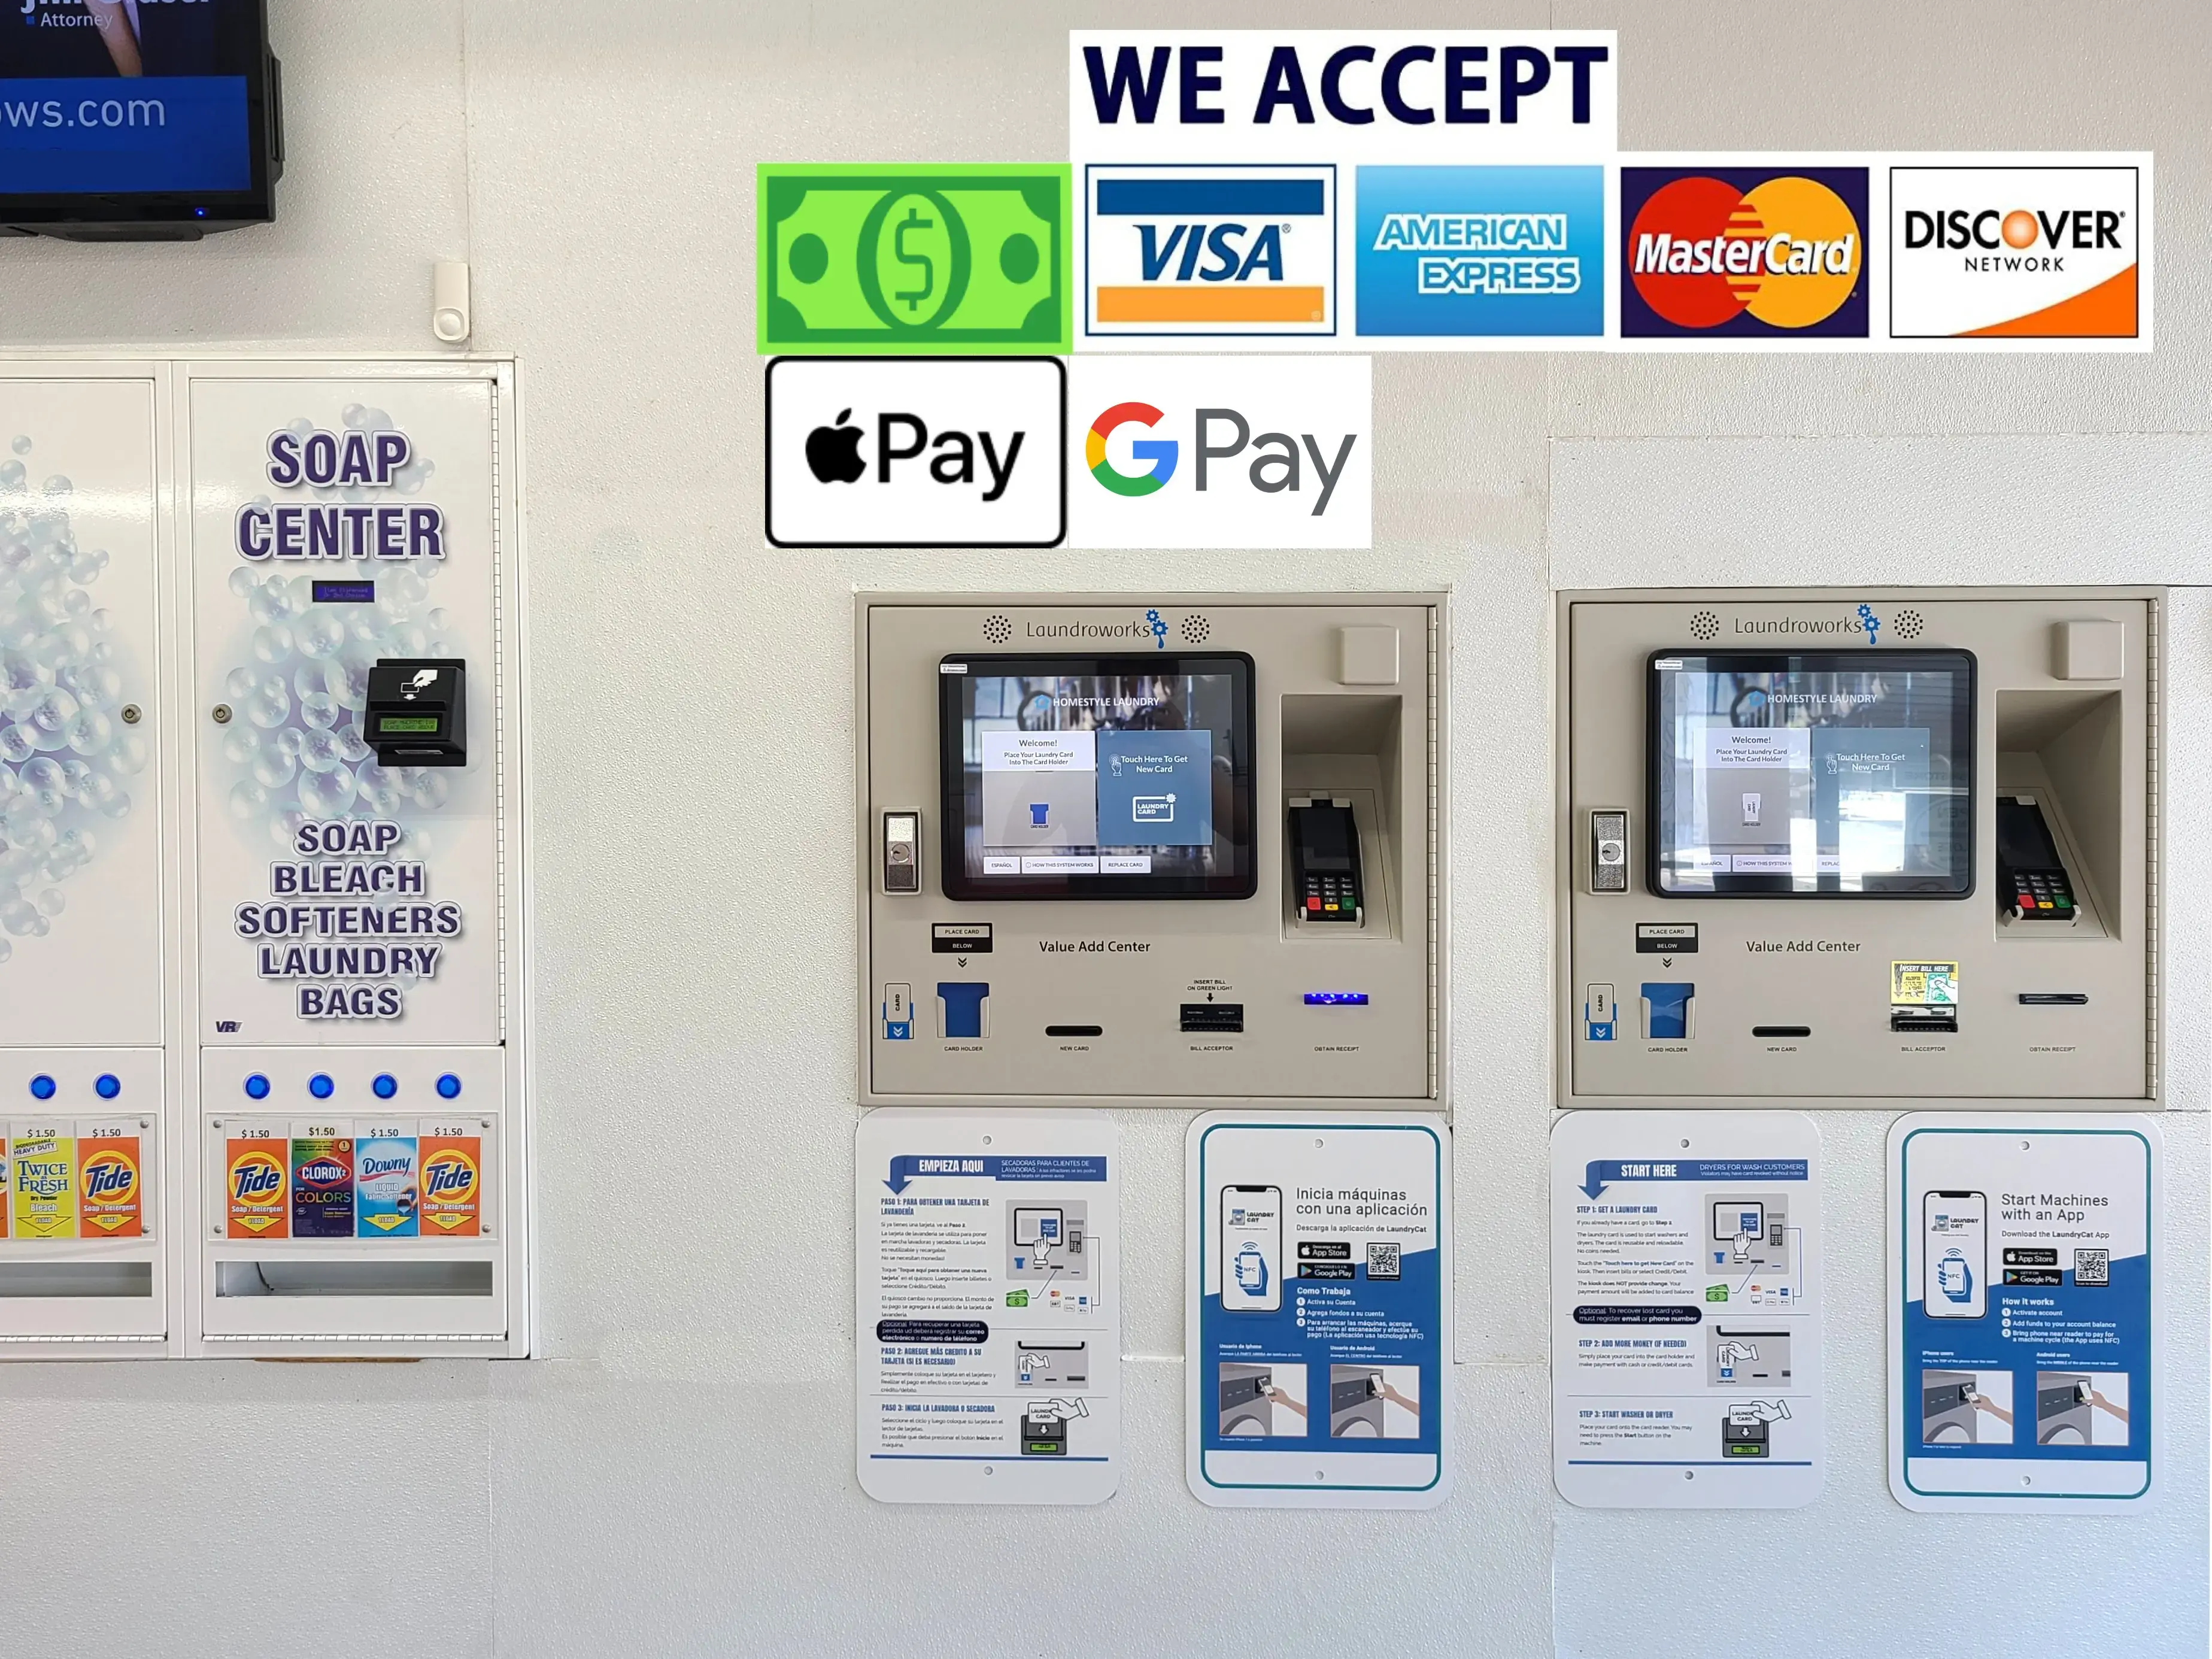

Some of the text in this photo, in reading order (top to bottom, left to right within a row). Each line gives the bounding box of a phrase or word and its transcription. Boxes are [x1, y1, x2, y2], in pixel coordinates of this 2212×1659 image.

[41, 13, 113, 29] Attorney
[0, 98, 166, 128] ws.com
[269, 432, 408, 484] SOAP
[239, 506, 442, 557] CENTER
[1027, 621, 1150, 637] Laundroworks
[1735, 617, 1862, 633] Laundroworks
[1053, 697, 1160, 707] HOMESTYLE LAUNDRY
[1768, 694, 1877, 704] HOMESTYLE LAUNDRY
[1019, 739, 1057, 747] Welcome!
[1731, 735, 1771, 745] Welcome!
[1035, 751, 1058, 760] Laundry
[1121, 755, 1188, 763] Touch Here To Get
[297, 823, 399, 853] SOAP
[274, 864, 423, 893] BLEACH
[238, 905, 459, 934] SOFTENERS
[1040, 941, 1150, 952] Value Add Center
[1747, 941, 1861, 953] Value Add Center
[261, 946, 439, 975] LAUNDRY
[300, 987, 399, 1016] BAGS
[28, 1129, 33, 1139] $
[92, 1129, 98, 1138] $
[242, 1130, 247, 1139] $
[309, 1127, 335, 1136] $1.50
[371, 1129, 376, 1138] $
[435, 1127, 439, 1137] $
[13, 1147, 35, 1156] HEAVY
[17, 1161, 67, 1175] TWICE
[363, 1158, 411, 1176] Downy
[920, 1160, 984, 1172] EMPIEZA AQUI
[1621, 1164, 1676, 1177] START HERE
[18, 1176, 68, 1195] FRESH
[86, 1164, 132, 1198] Tide
[233, 1165, 281, 1199] Tide
[426, 1163, 473, 1197] Tide
[375, 1183, 399, 1191] LIQUID
[296, 1192, 351, 1203] COLORS
[1297, 1188, 1407, 1203] Inicia máquinas
[2001, 1194, 2108, 1206] Start Machines
[31, 1203, 57, 1212] Bleach
[881, 1207, 914, 1215] LAVANDERÍA
[1297, 1203, 1427, 1218] con una aplicación
[2001, 1209, 2084, 1223] with an App
[2052, 1231, 2093, 1239] LaundryCat
